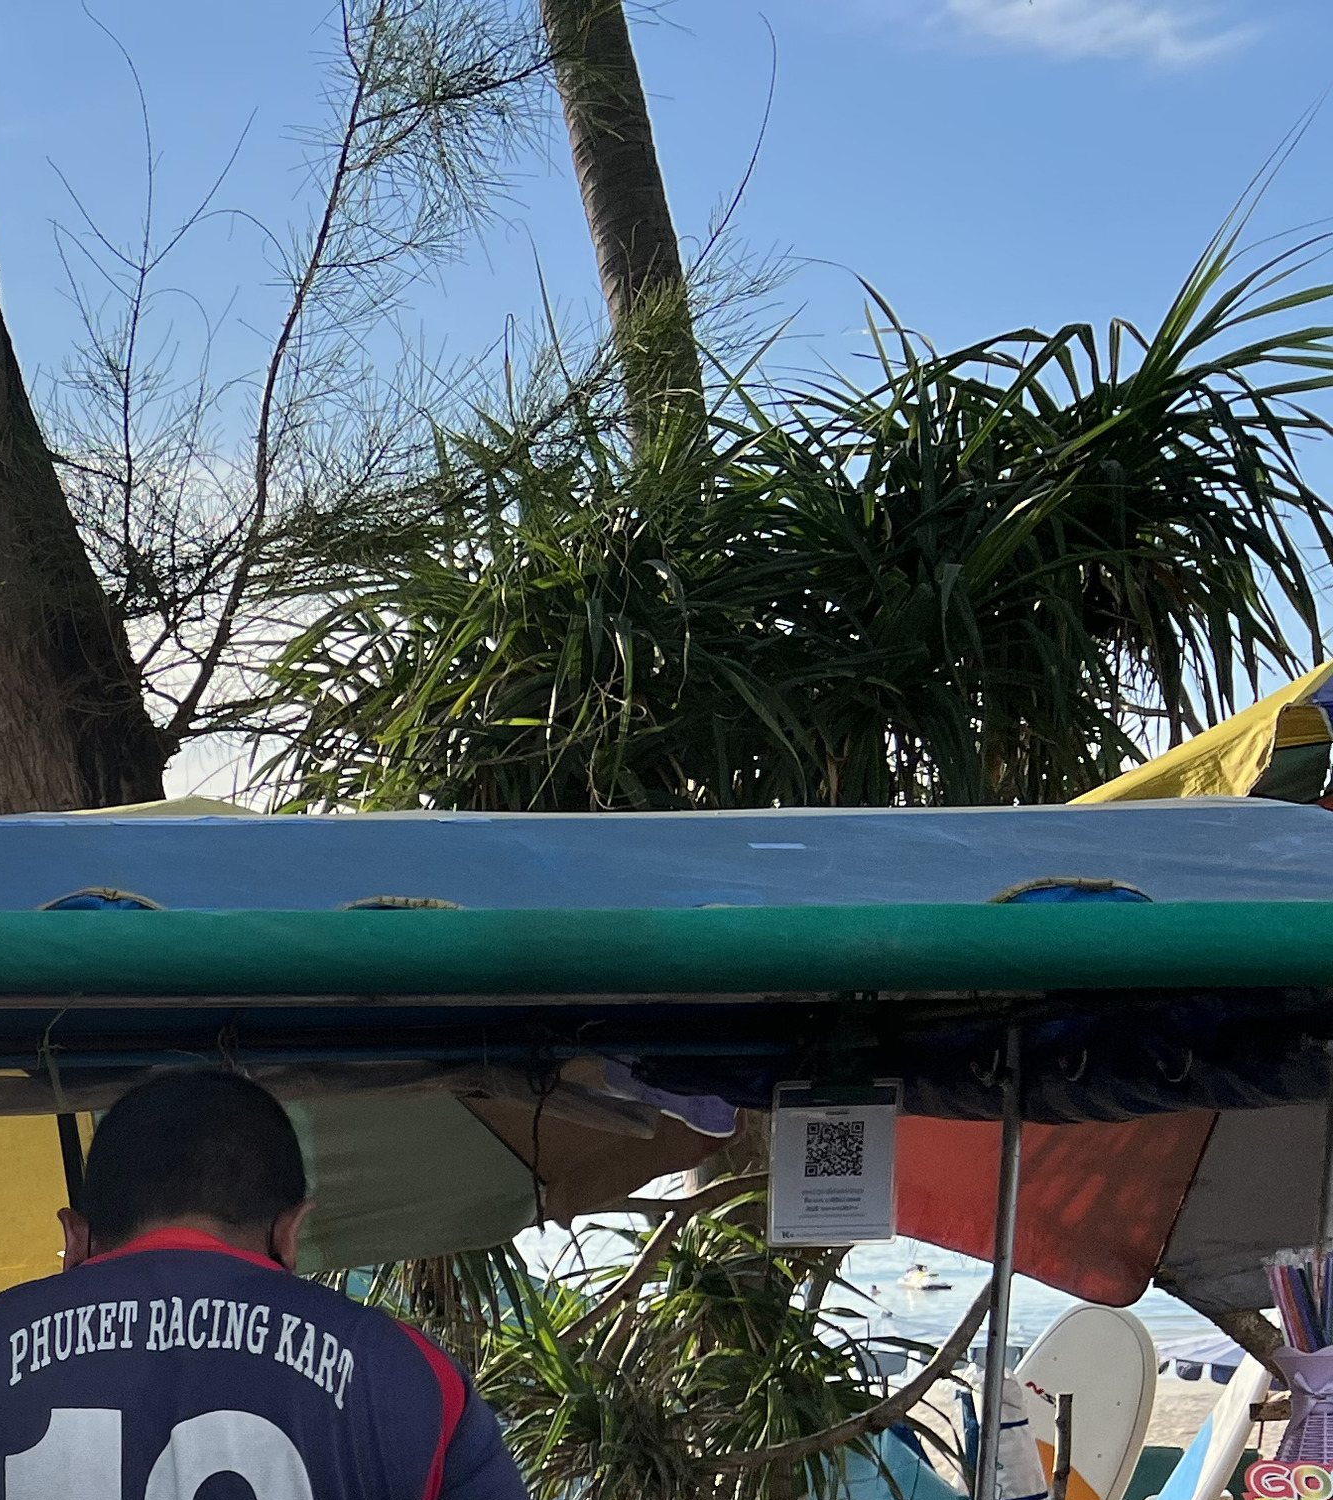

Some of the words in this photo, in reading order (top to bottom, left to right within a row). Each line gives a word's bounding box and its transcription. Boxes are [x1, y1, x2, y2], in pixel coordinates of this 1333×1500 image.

[8, 1300, 138, 1387] PHUKET
[145, 1297, 270, 1355] RACING
[274, 1314, 355, 1411] KART
